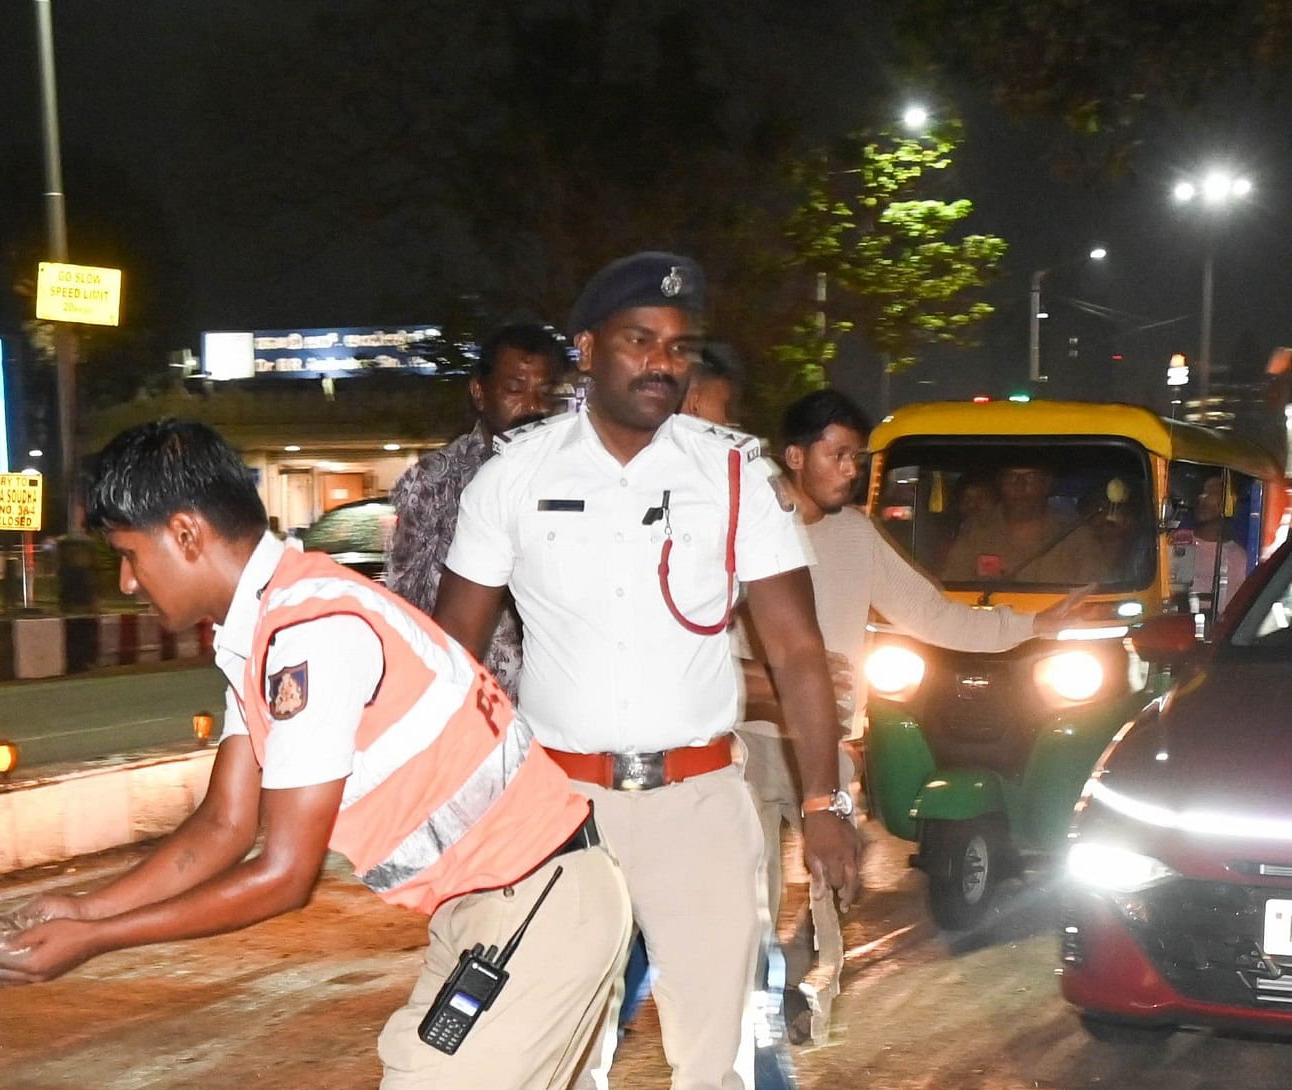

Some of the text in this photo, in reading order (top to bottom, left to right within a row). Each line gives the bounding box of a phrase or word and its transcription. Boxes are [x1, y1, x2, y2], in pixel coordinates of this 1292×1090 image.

[59, 271, 101, 284] GO SLOW
[50, 287, 109, 300] SPEED LIMIT
[16, 477, 28, 487] TO
[7, 489, 37, 504] SOUDHA
